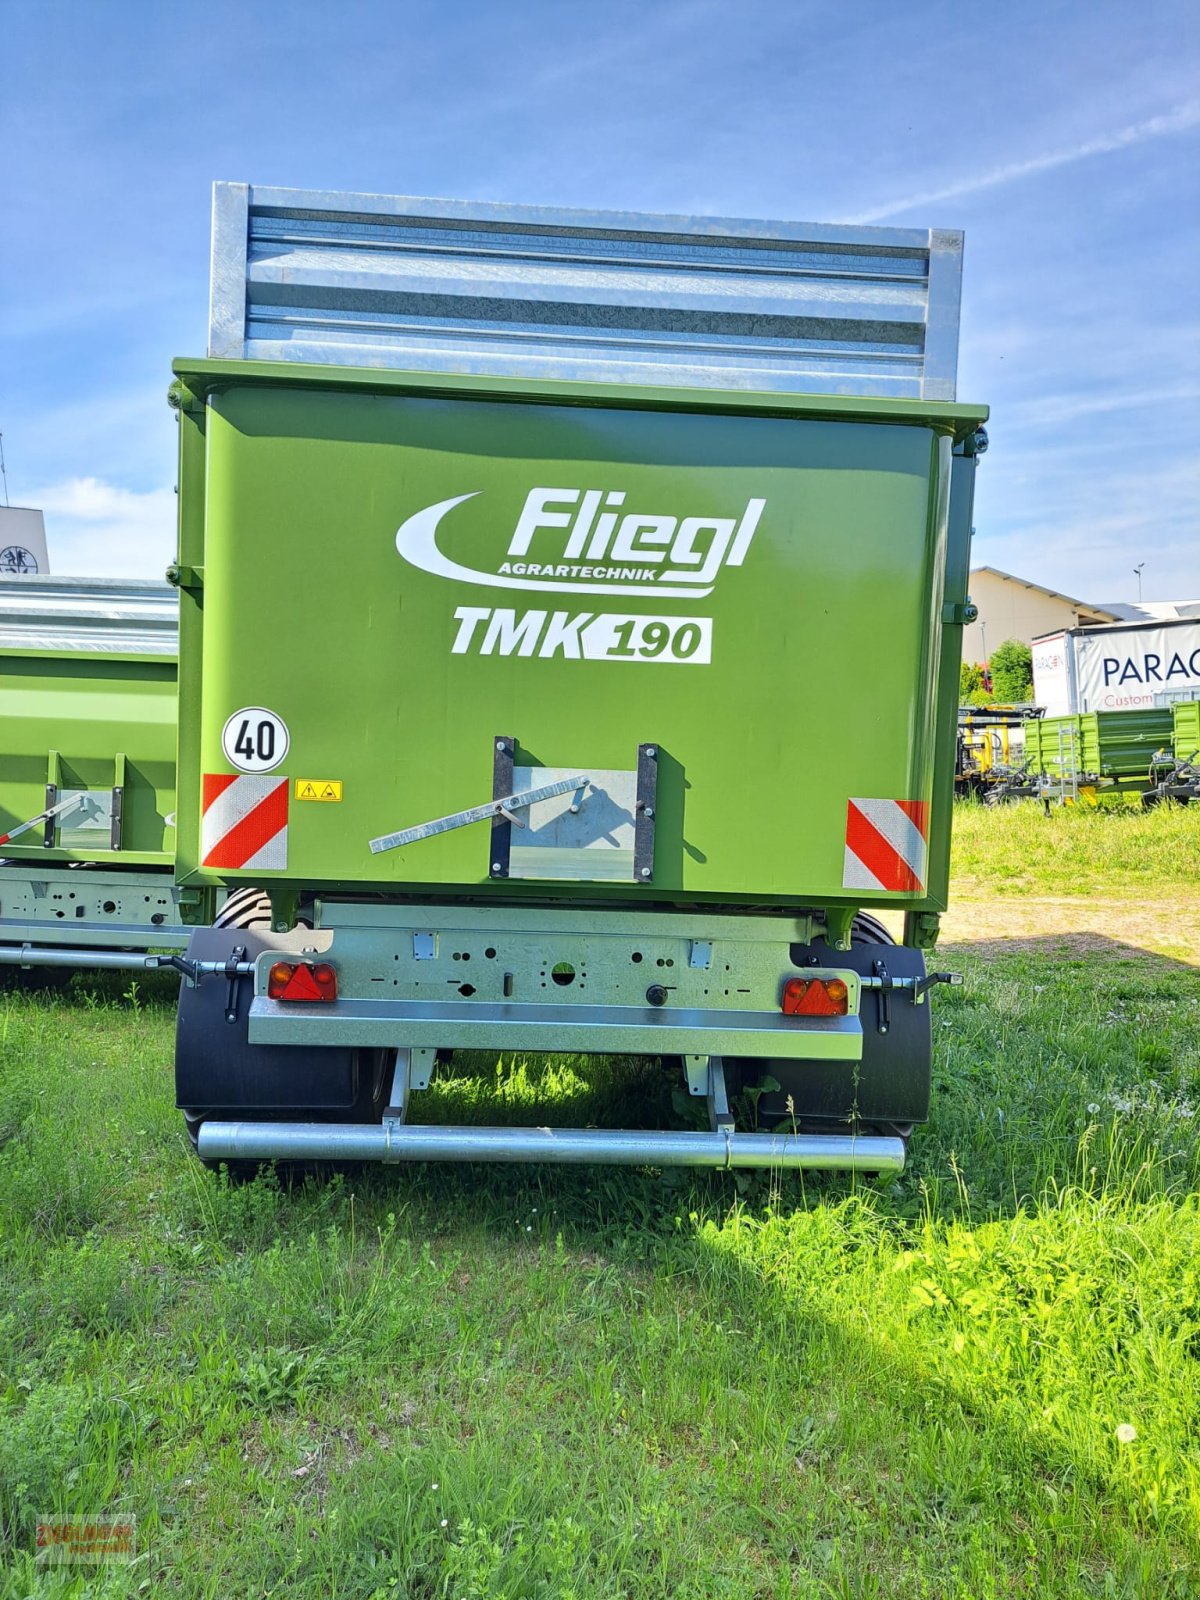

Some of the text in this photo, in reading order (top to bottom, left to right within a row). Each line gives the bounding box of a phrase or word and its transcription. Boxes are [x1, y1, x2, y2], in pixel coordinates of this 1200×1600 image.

[507, 487, 767, 584] Fliegl
[497, 561, 658, 581] AGRARTECHNIK
[451, 606, 703, 660] TMK 190
[1104, 694, 1153, 707] Custom
[234, 719, 275, 761] 40
